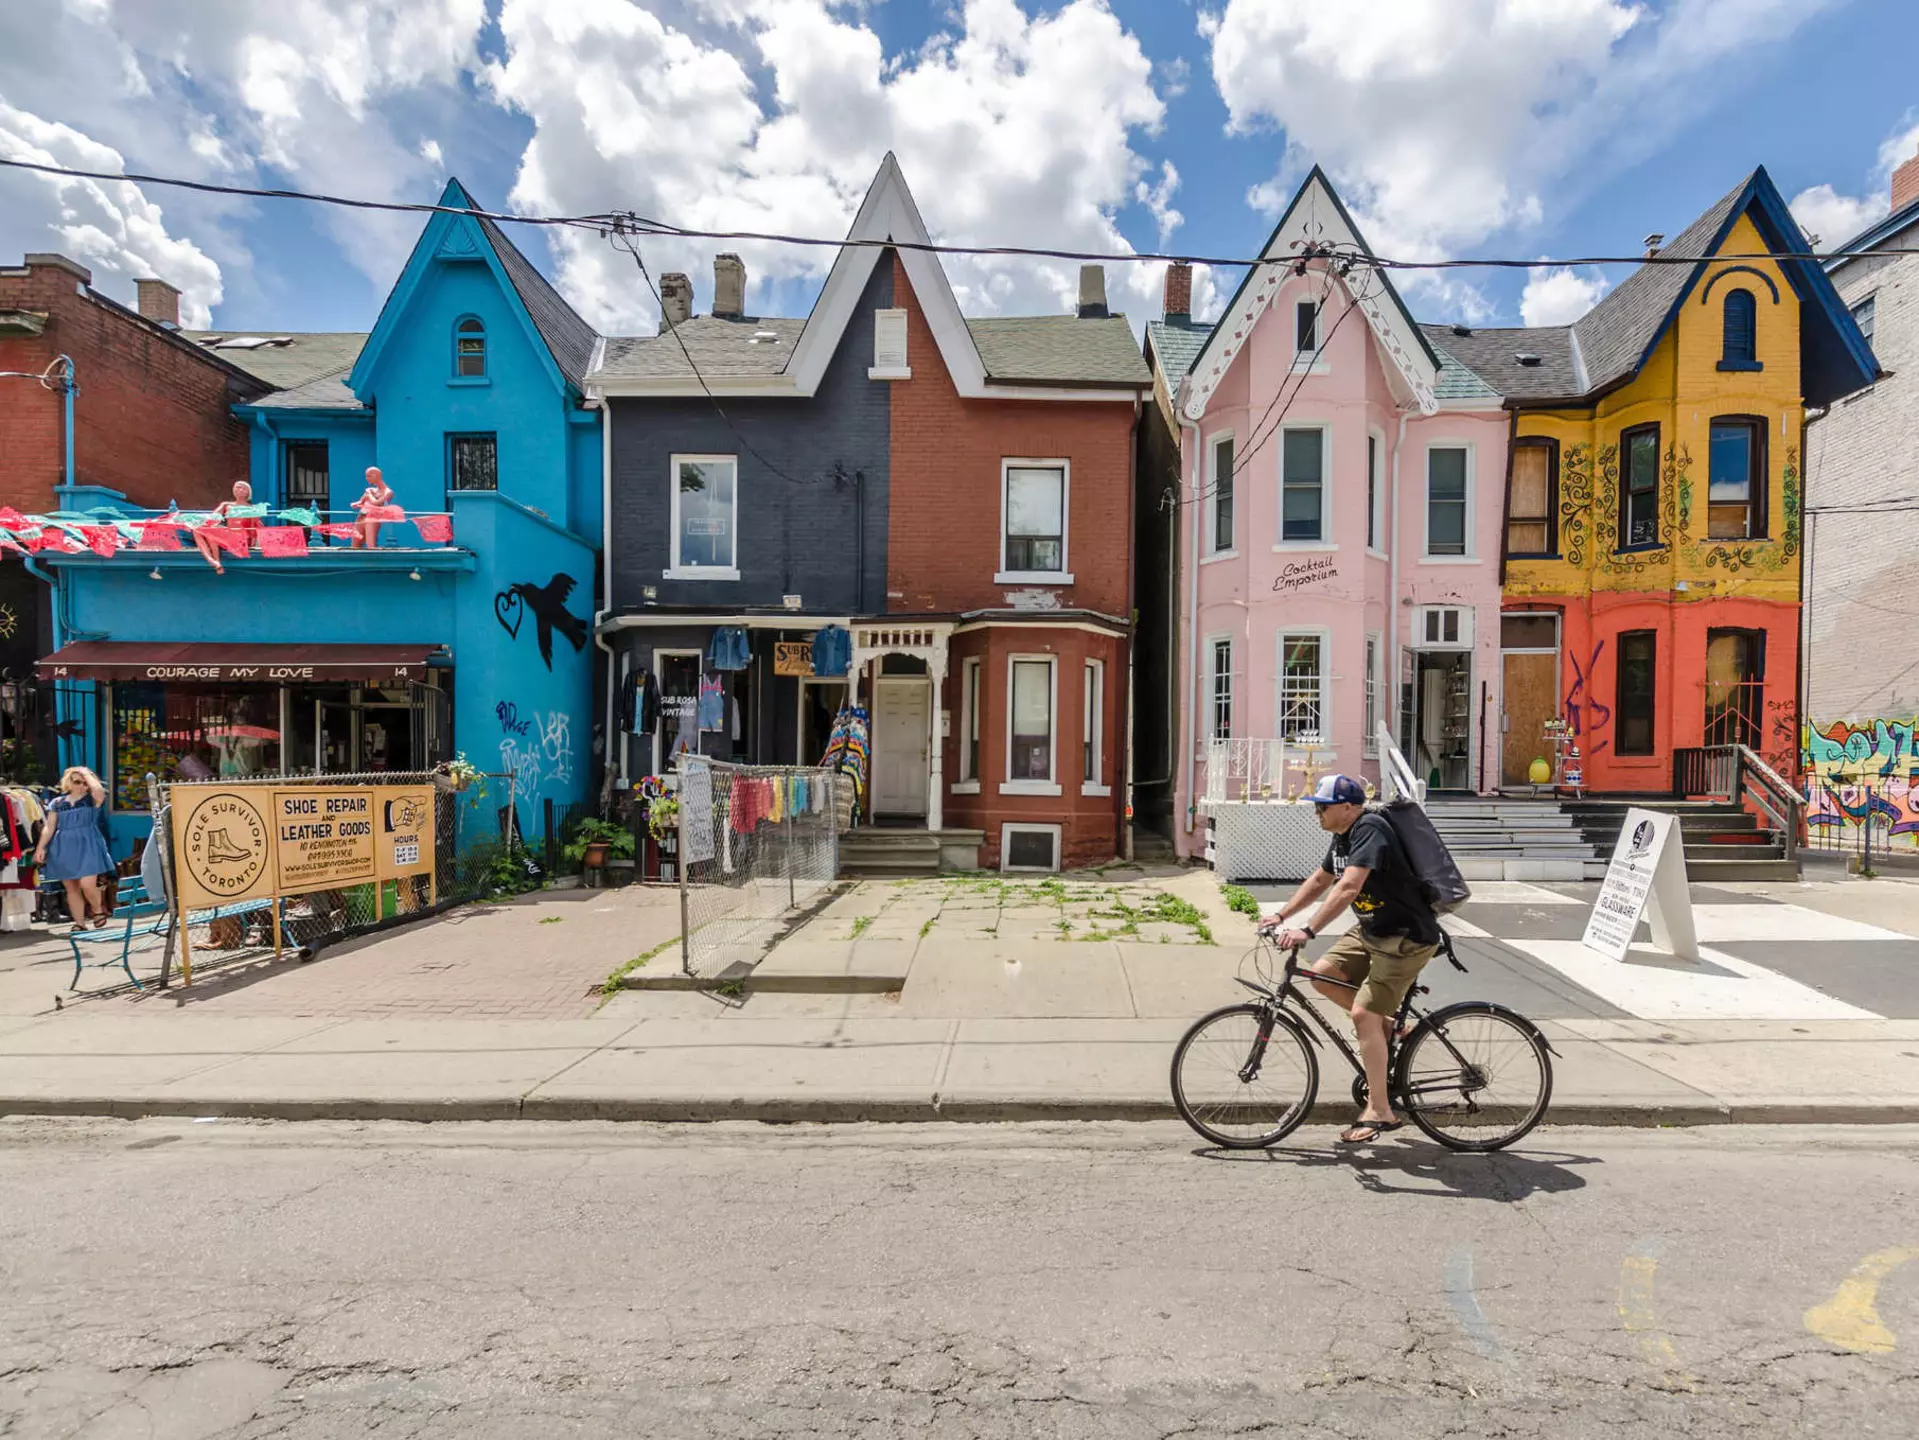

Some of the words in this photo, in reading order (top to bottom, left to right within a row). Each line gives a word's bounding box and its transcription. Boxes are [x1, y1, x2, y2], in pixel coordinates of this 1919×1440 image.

[1283, 555, 1333, 577] Cocktail
[1273, 569, 1339, 592] Emporium
[54, 666, 68, 677] 14
[147, 666, 220, 678] COURAGE
[230, 667, 258, 677] MY
[269, 667, 313, 678] LOVE
[395, 667, 408, 676] 14
[660, 696, 676, 704] SUB
[676, 696, 697, 705] ROSA
[661, 708, 696, 717] VINTAGE
[284, 800, 318, 814] SHOE
[326, 798, 367, 812] REPAIR
[192, 814, 210, 852] SOLE
[212, 803, 262, 847] SURVIVOR
[281, 824, 333, 841] LEATHER
[339, 821, 371, 837] GOODS
[393, 834, 419, 844] HOURS
[202, 861, 257, 888] TORONTO
